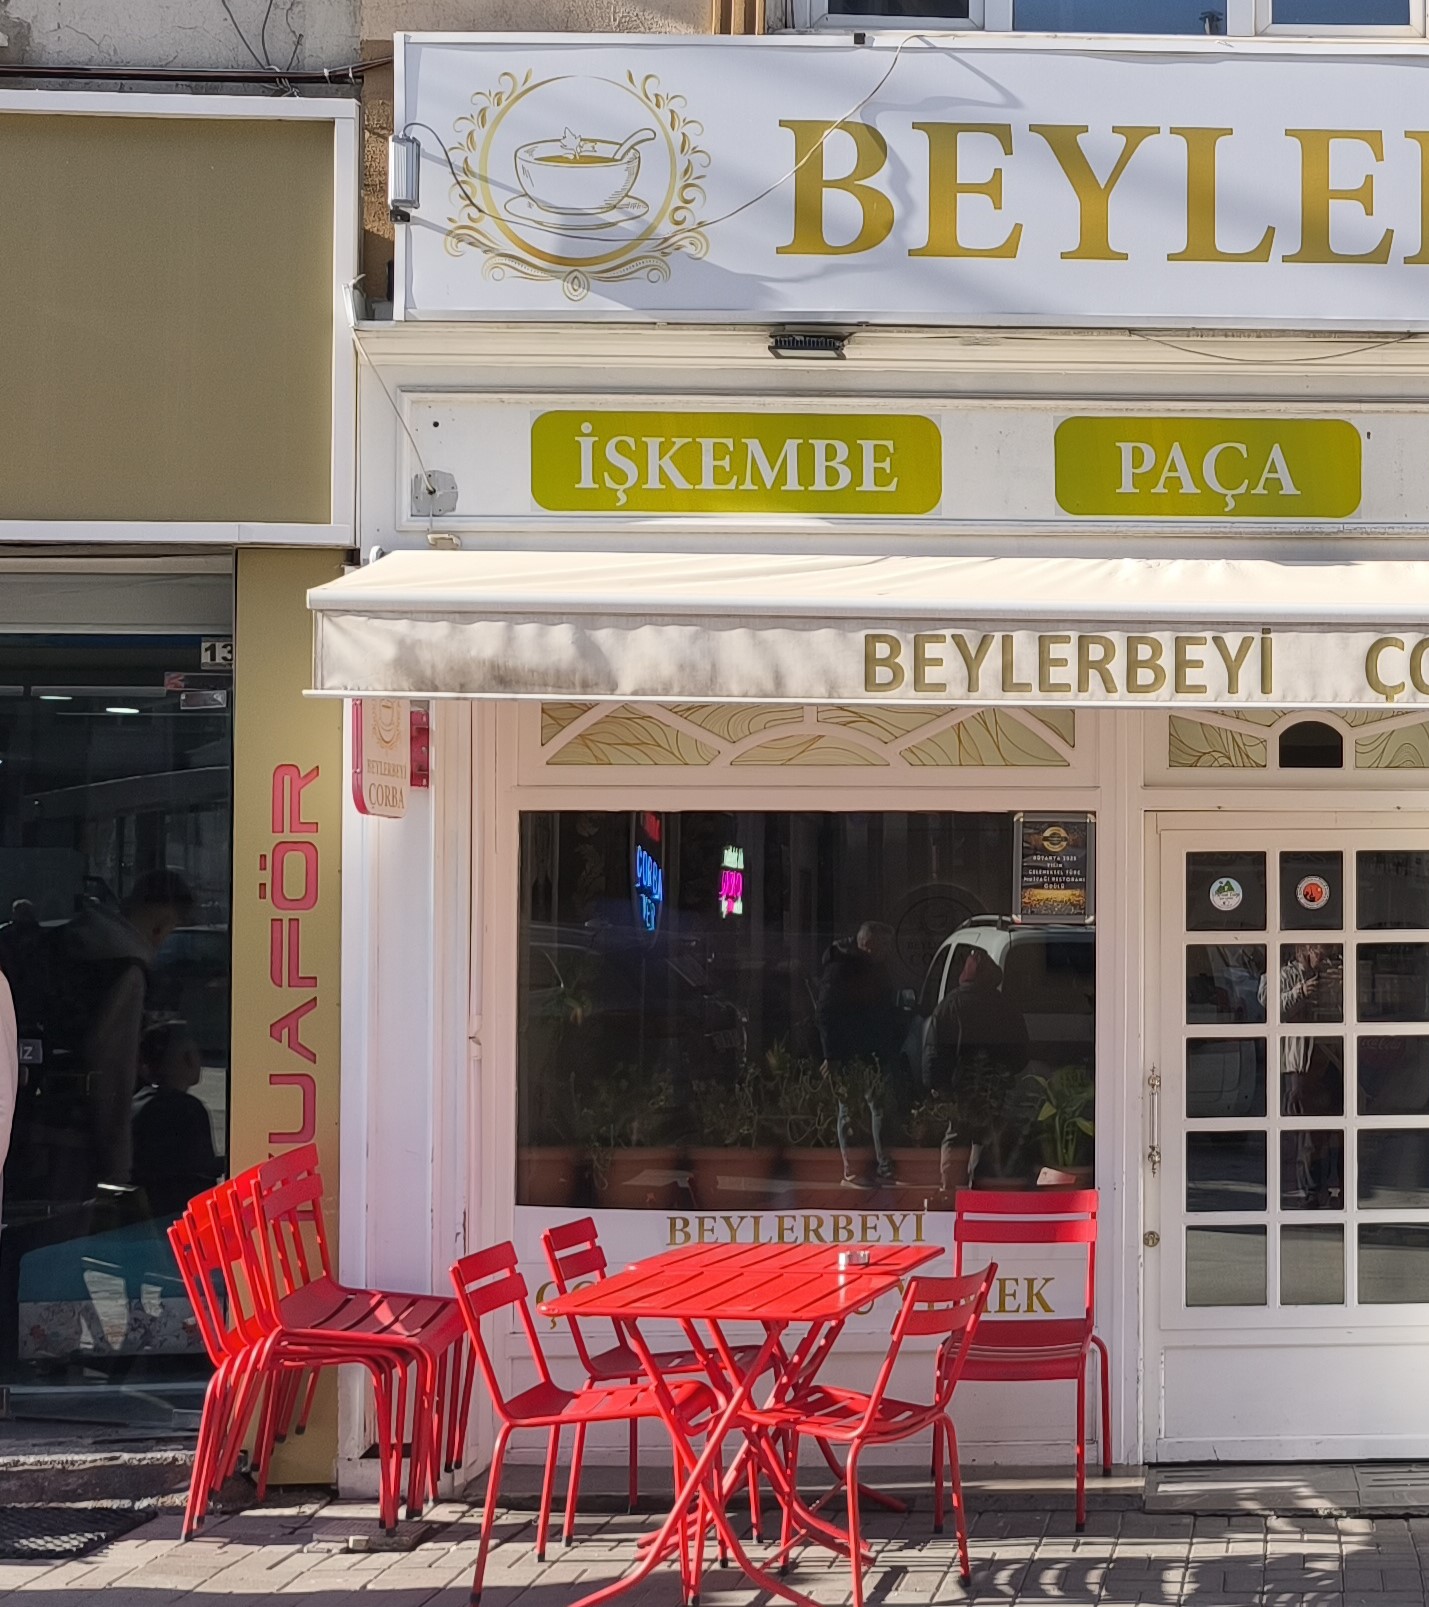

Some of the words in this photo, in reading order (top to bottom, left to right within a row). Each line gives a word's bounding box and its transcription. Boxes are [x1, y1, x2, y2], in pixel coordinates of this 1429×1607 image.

[573, 421, 899, 505] İŞKEMBE
[1115, 441, 1302, 511] PAÇA
[204, 643, 233, 662] 13
[864, 628, 1273, 695] BEYLERBEYİ
[368, 783, 405, 809] ÇORBA
[258, 763, 320, 1222] UAFÖR
